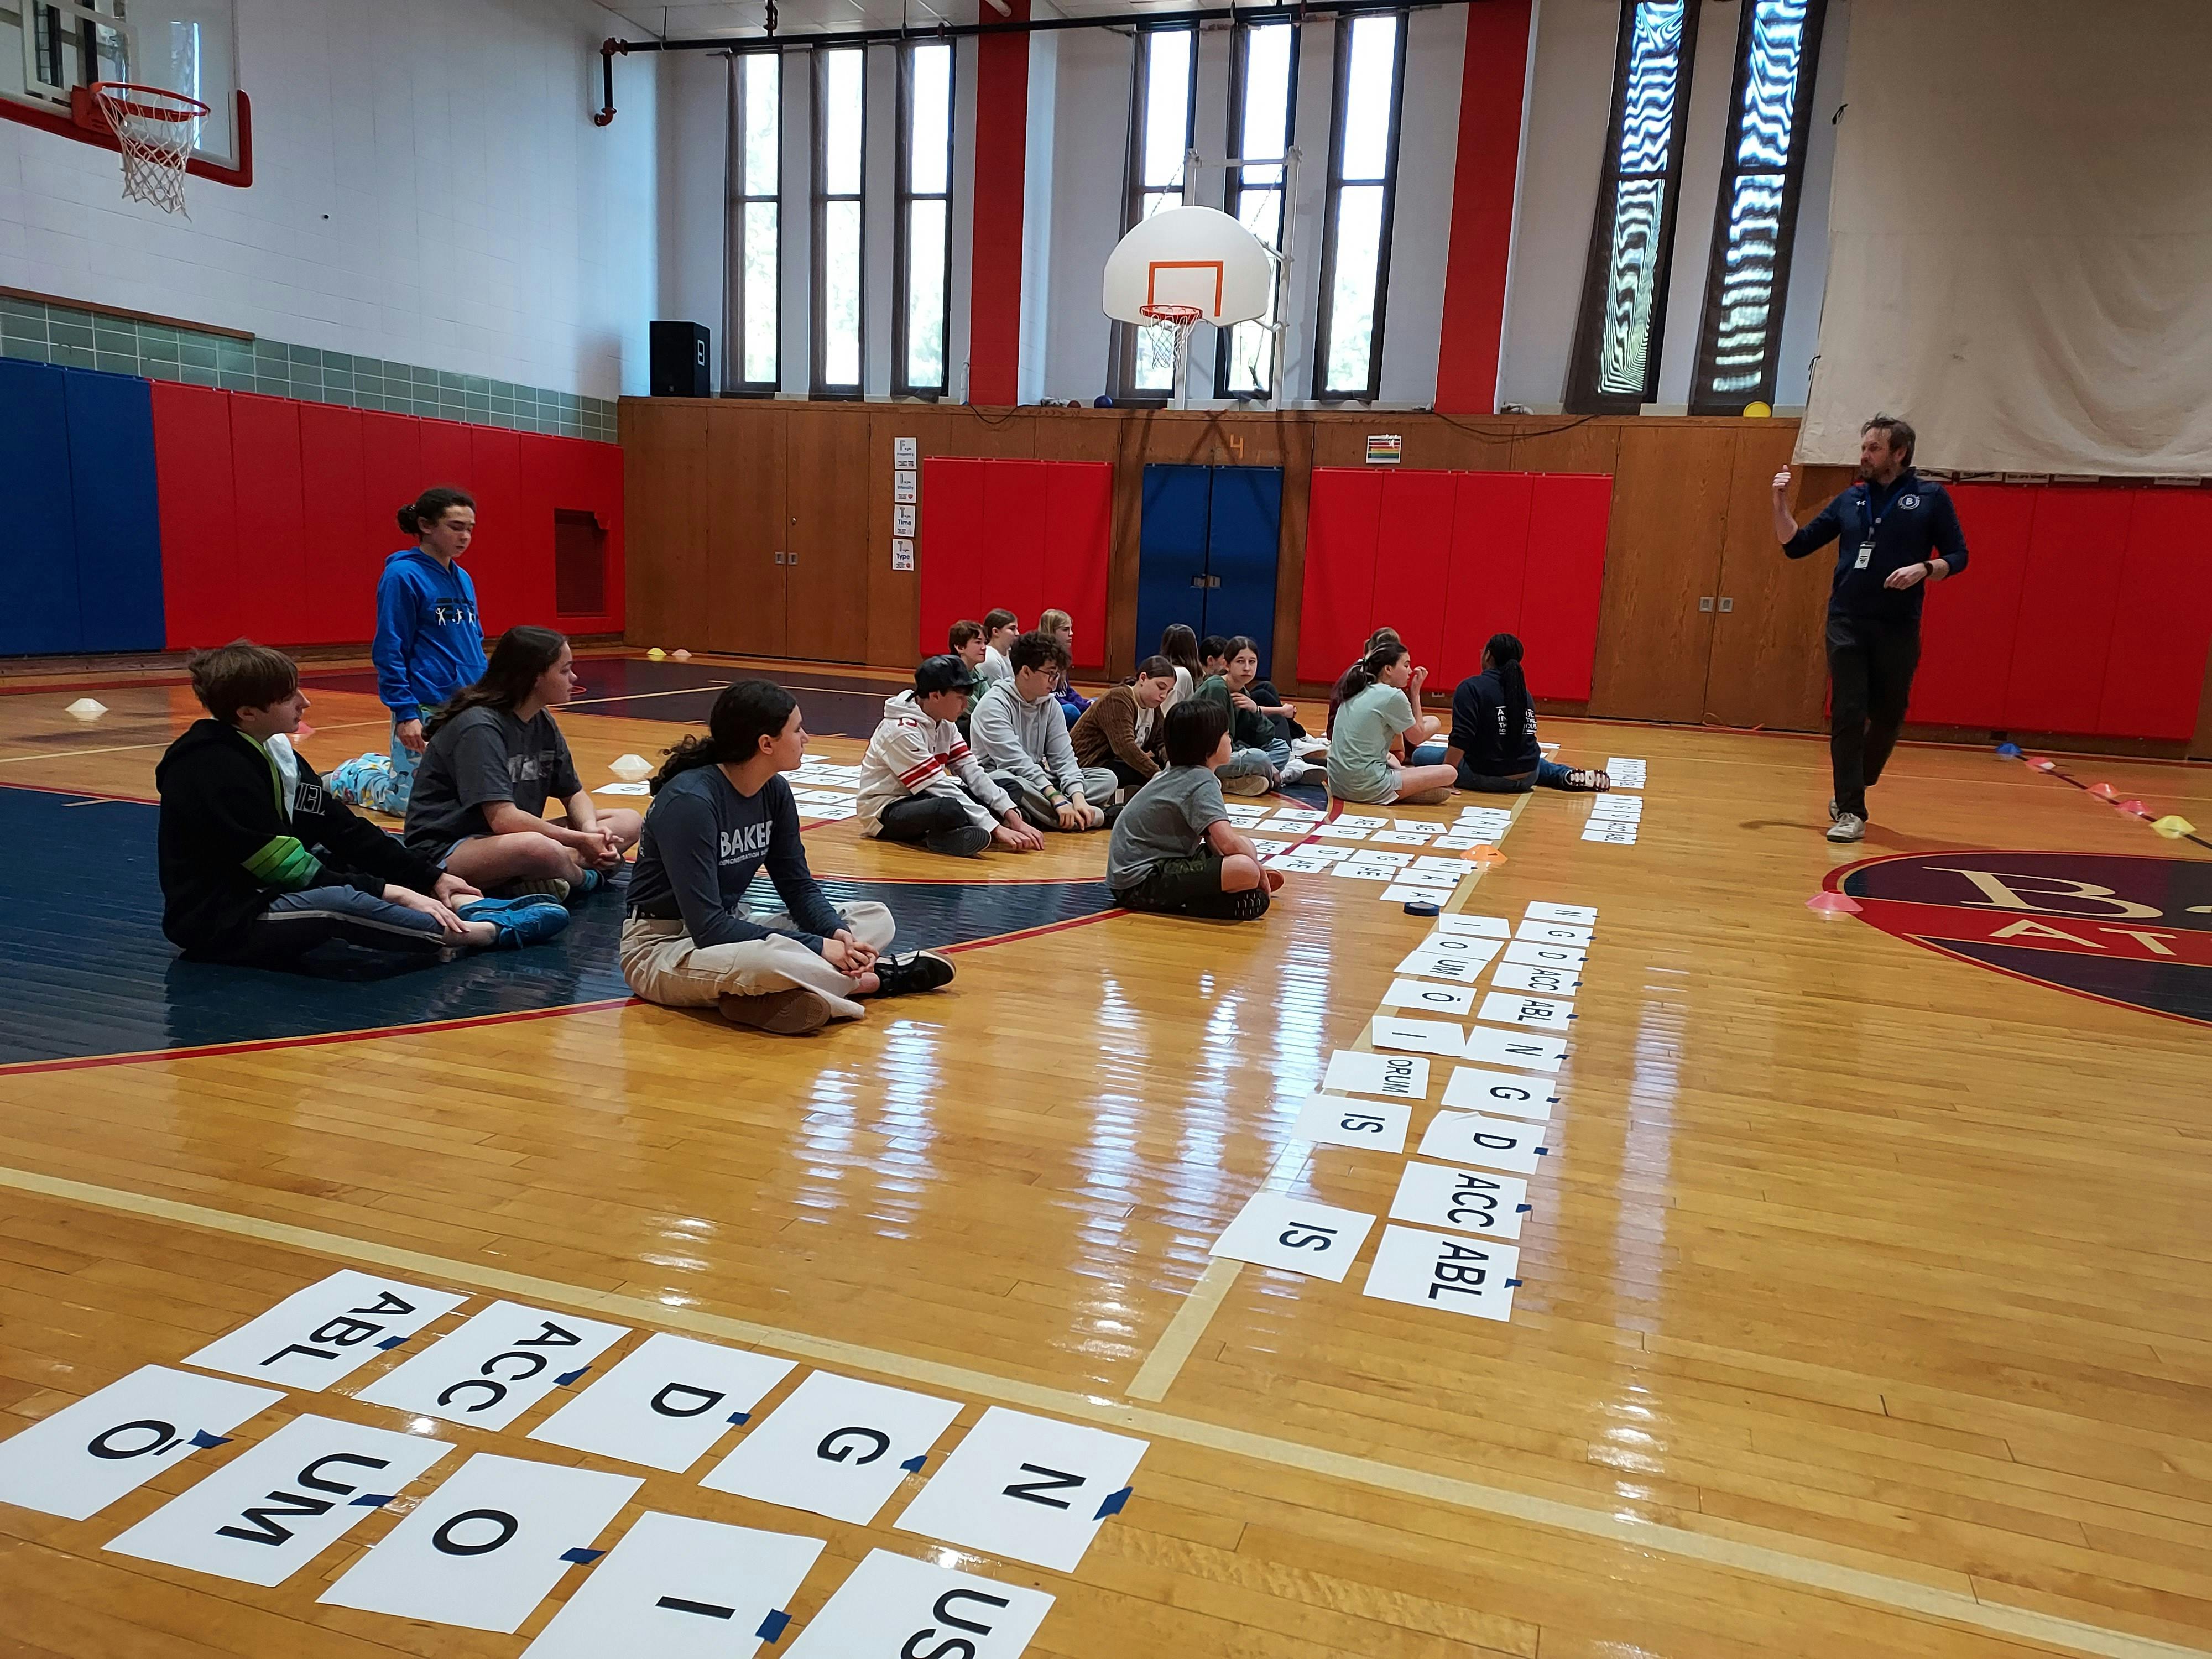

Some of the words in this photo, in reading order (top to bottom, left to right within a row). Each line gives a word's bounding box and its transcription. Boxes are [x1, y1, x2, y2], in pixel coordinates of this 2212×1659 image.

[1230, 434, 1244, 460] 4
[1279, 822, 1303, 832] ACC
[1287, 859, 1314, 869] AE
[1357, 866, 1380, 877] AE
[1439, 941, 1468, 950] O
[1538, 951, 1567, 959] D
[1430, 959, 1469, 976] UM
[1528, 969, 1558, 991] ACC
[1518, 999, 1555, 1021] ABL
[1505, 1044, 1543, 1056] N
[1383, 1059, 1413, 1093] ORUM
[1490, 1086, 1531, 1101] G
[1340, 1113, 1386, 1134] IS
[1473, 1133, 1517, 1149] D
[1447, 1173, 1500, 1228] ACC
[1279, 1222, 1338, 1251] IS
[1428, 1241, 1488, 1299] ABL
[260, 1291, 416, 1366] ABL
[436, 1321, 582, 1412] ACC
[650, 1382, 726, 1417] D
[817, 1426, 890, 1465] G
[1002, 1462, 1086, 1510] N
[215, 1453, 391, 1546] UM
[432, 1509, 518, 1555] O
